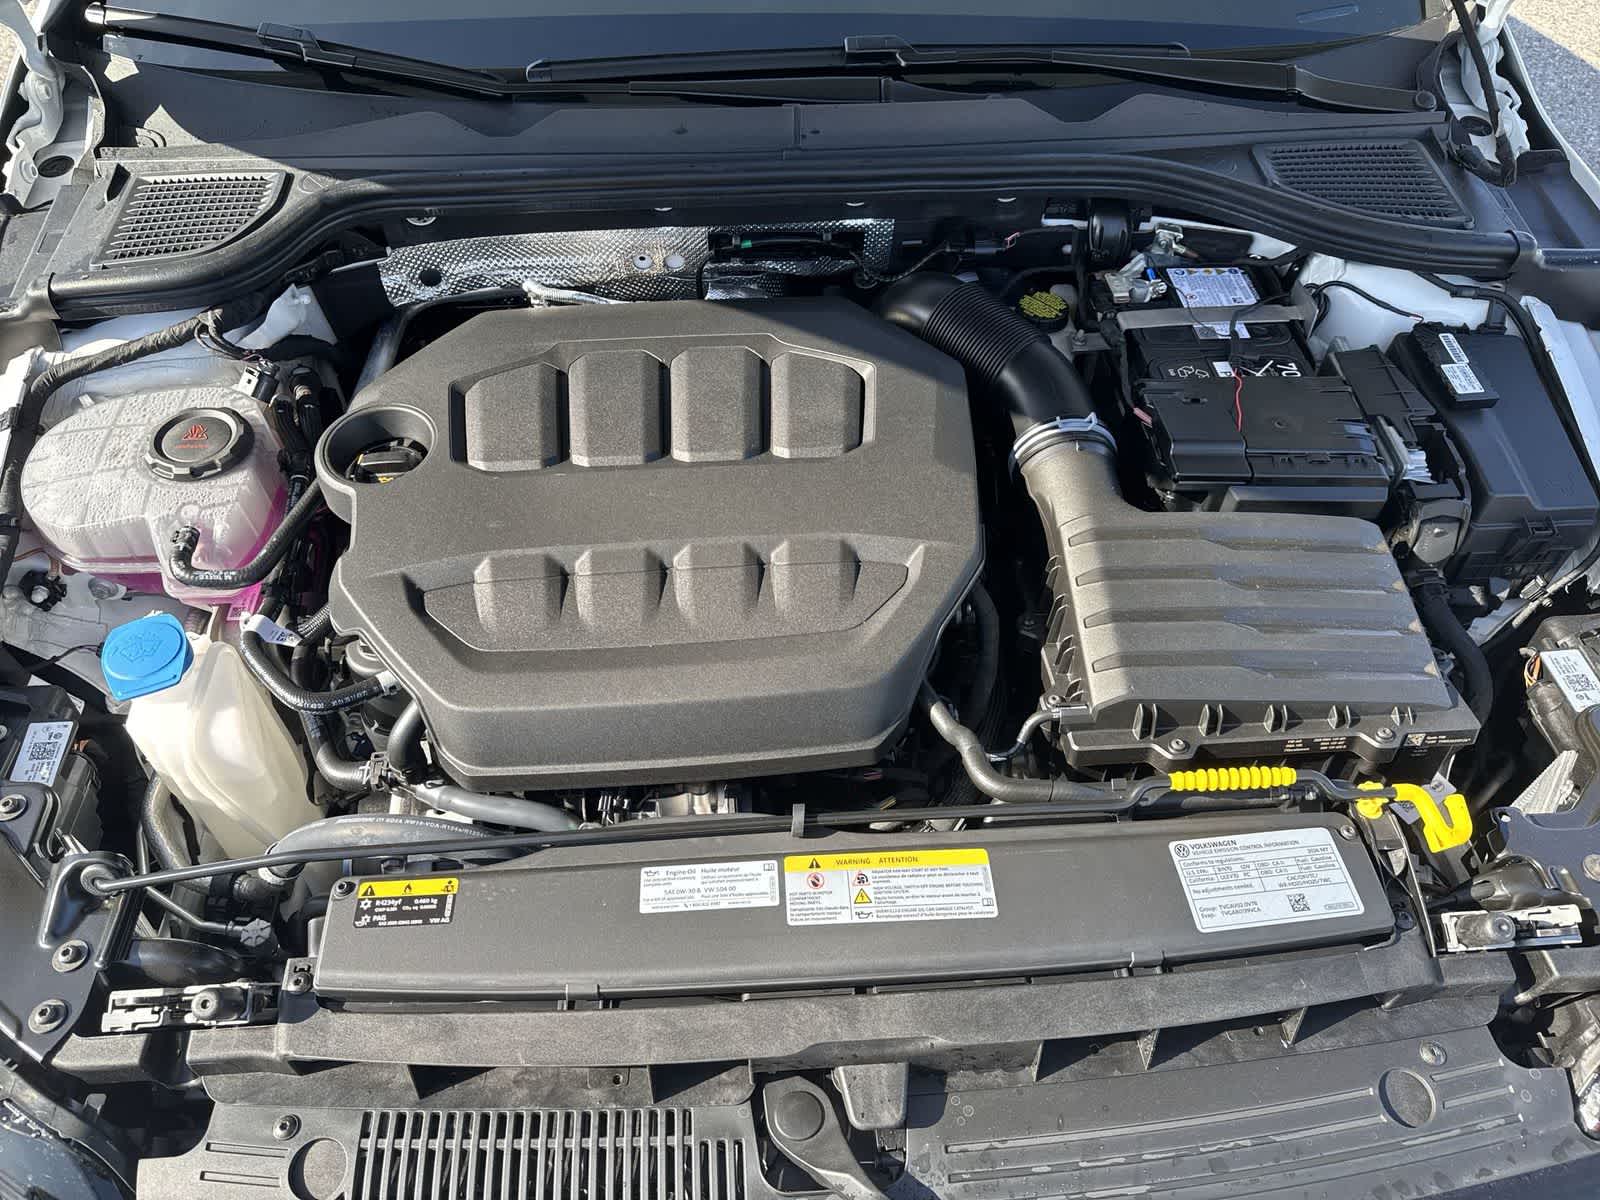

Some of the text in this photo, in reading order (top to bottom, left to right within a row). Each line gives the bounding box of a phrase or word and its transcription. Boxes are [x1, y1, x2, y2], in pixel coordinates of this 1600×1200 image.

[1189, 840, 1237, 850] VOLKSWAGEN
[1264, 840, 1299, 848] INFORMATION
[878, 856, 919, 864] ATTENTION
